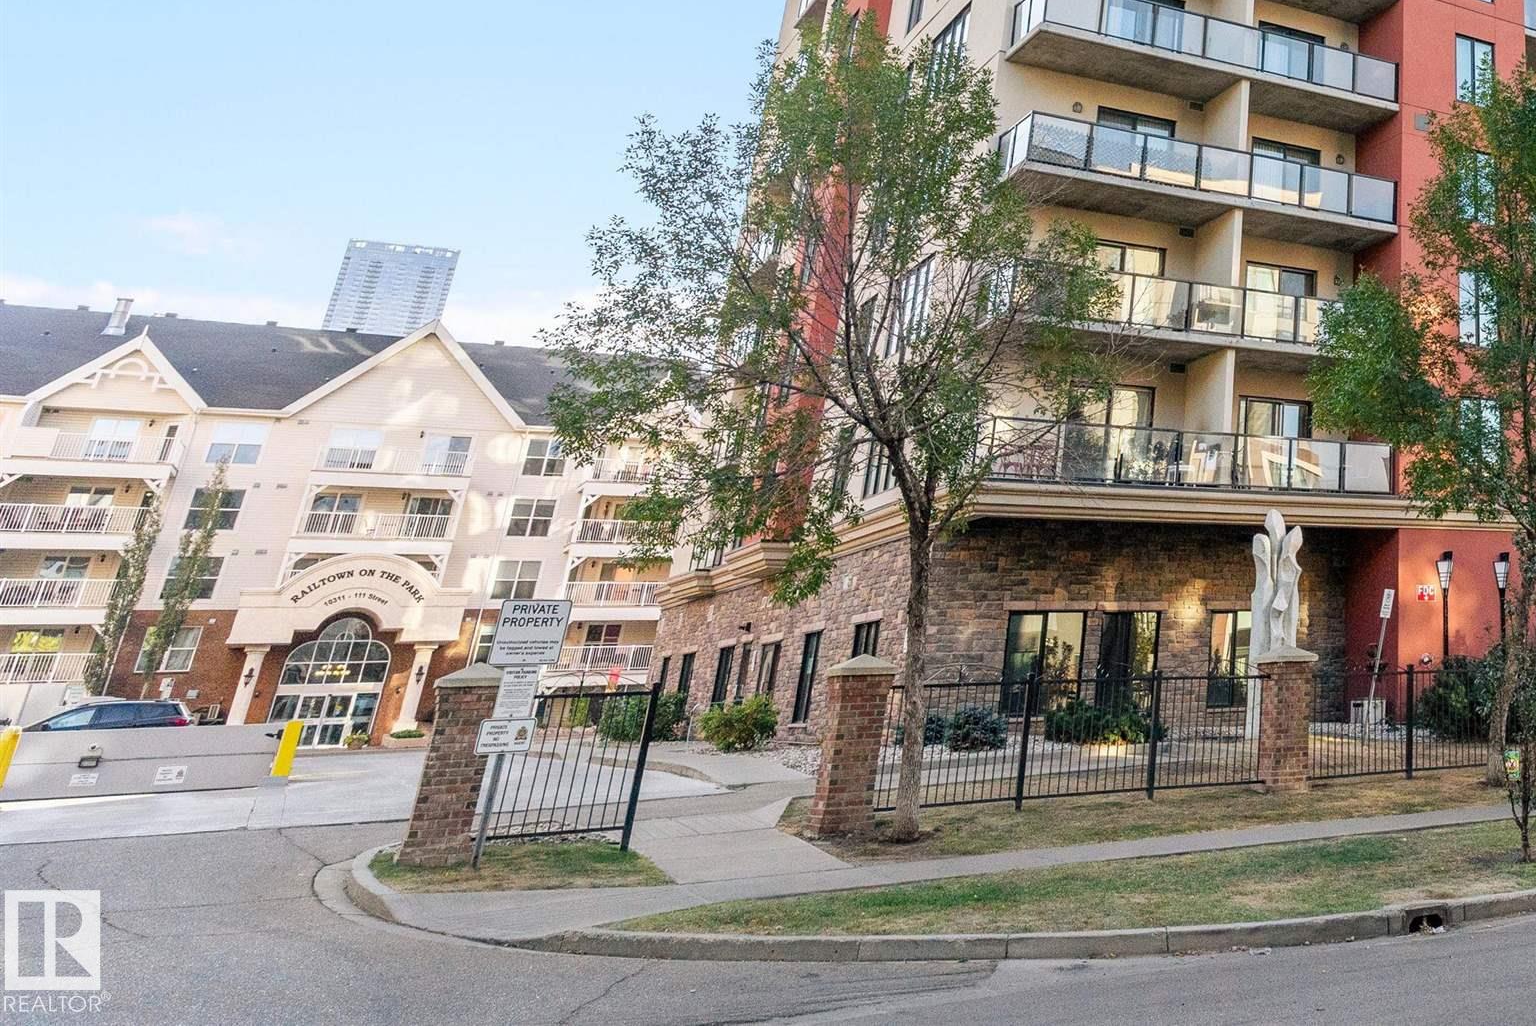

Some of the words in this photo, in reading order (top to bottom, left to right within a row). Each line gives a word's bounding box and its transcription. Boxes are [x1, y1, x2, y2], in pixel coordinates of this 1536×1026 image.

[290, 569, 355, 604] RAILTOWN
[359, 568, 377, 577] ON
[379, 570, 403, 584] THE
[401, 580, 425, 604] PARK
[1418, 585, 1435, 595] FDC
[324, 594, 346, 607] 10311
[367, 592, 389, 606] Street
[512, 604, 560, 614] PRIVATE
[502, 617, 564, 627] PROPERTY
